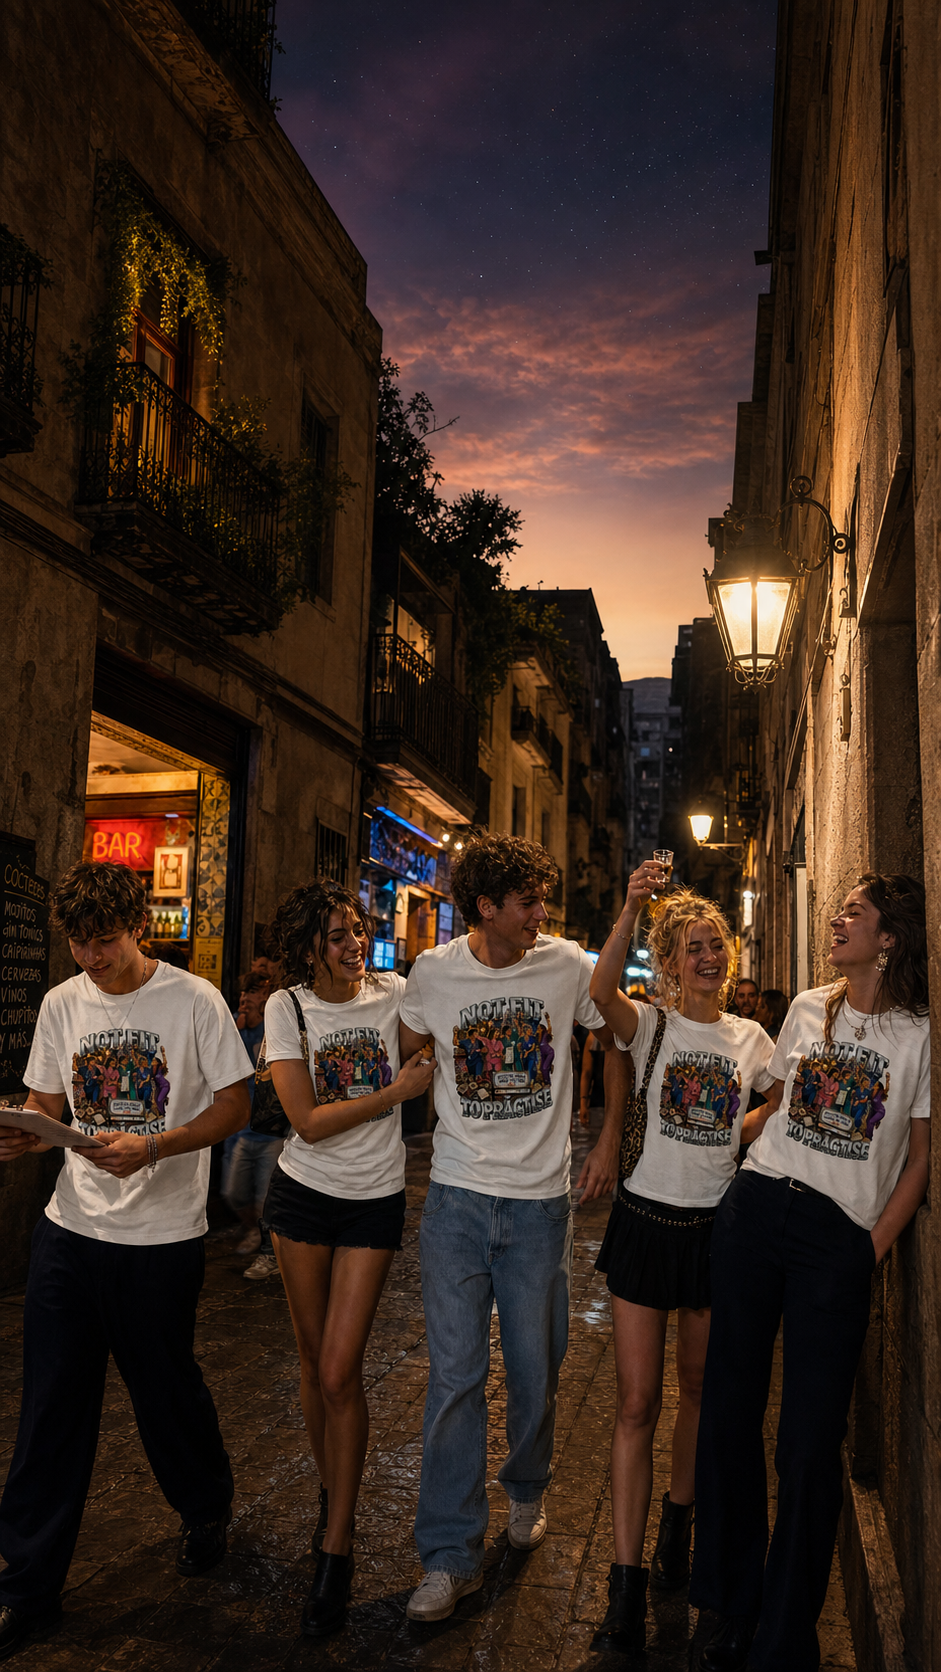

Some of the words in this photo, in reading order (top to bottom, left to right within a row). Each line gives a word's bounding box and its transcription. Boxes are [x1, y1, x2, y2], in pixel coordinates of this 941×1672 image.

[93, 831, 141, 858] BAR
[460, 996, 507, 1030] NOT
[508, 996, 545, 1020] FIT
[0, 1033, 6, 1054] Y
[80, 1029, 123, 1057] NOT
[125, 1029, 160, 1053] FIT
[319, 1028, 354, 1052] NOT
[354, 1027, 380, 1045] FIT
[672, 1051, 708, 1070] NOT
[708, 1053, 738, 1076] FIT
[809, 1041, 855, 1064] NOT
[855, 1045, 891, 1078] FIT
[460, 1098, 483, 1119] TO
[482, 1089, 554, 1120] PRACTISE
[660, 1119, 676, 1139] TO
[675, 1126, 732, 1148] PRACTISE
[785, 1119, 805, 1142] TO
[802, 1128, 871, 1161] PRACTISE
